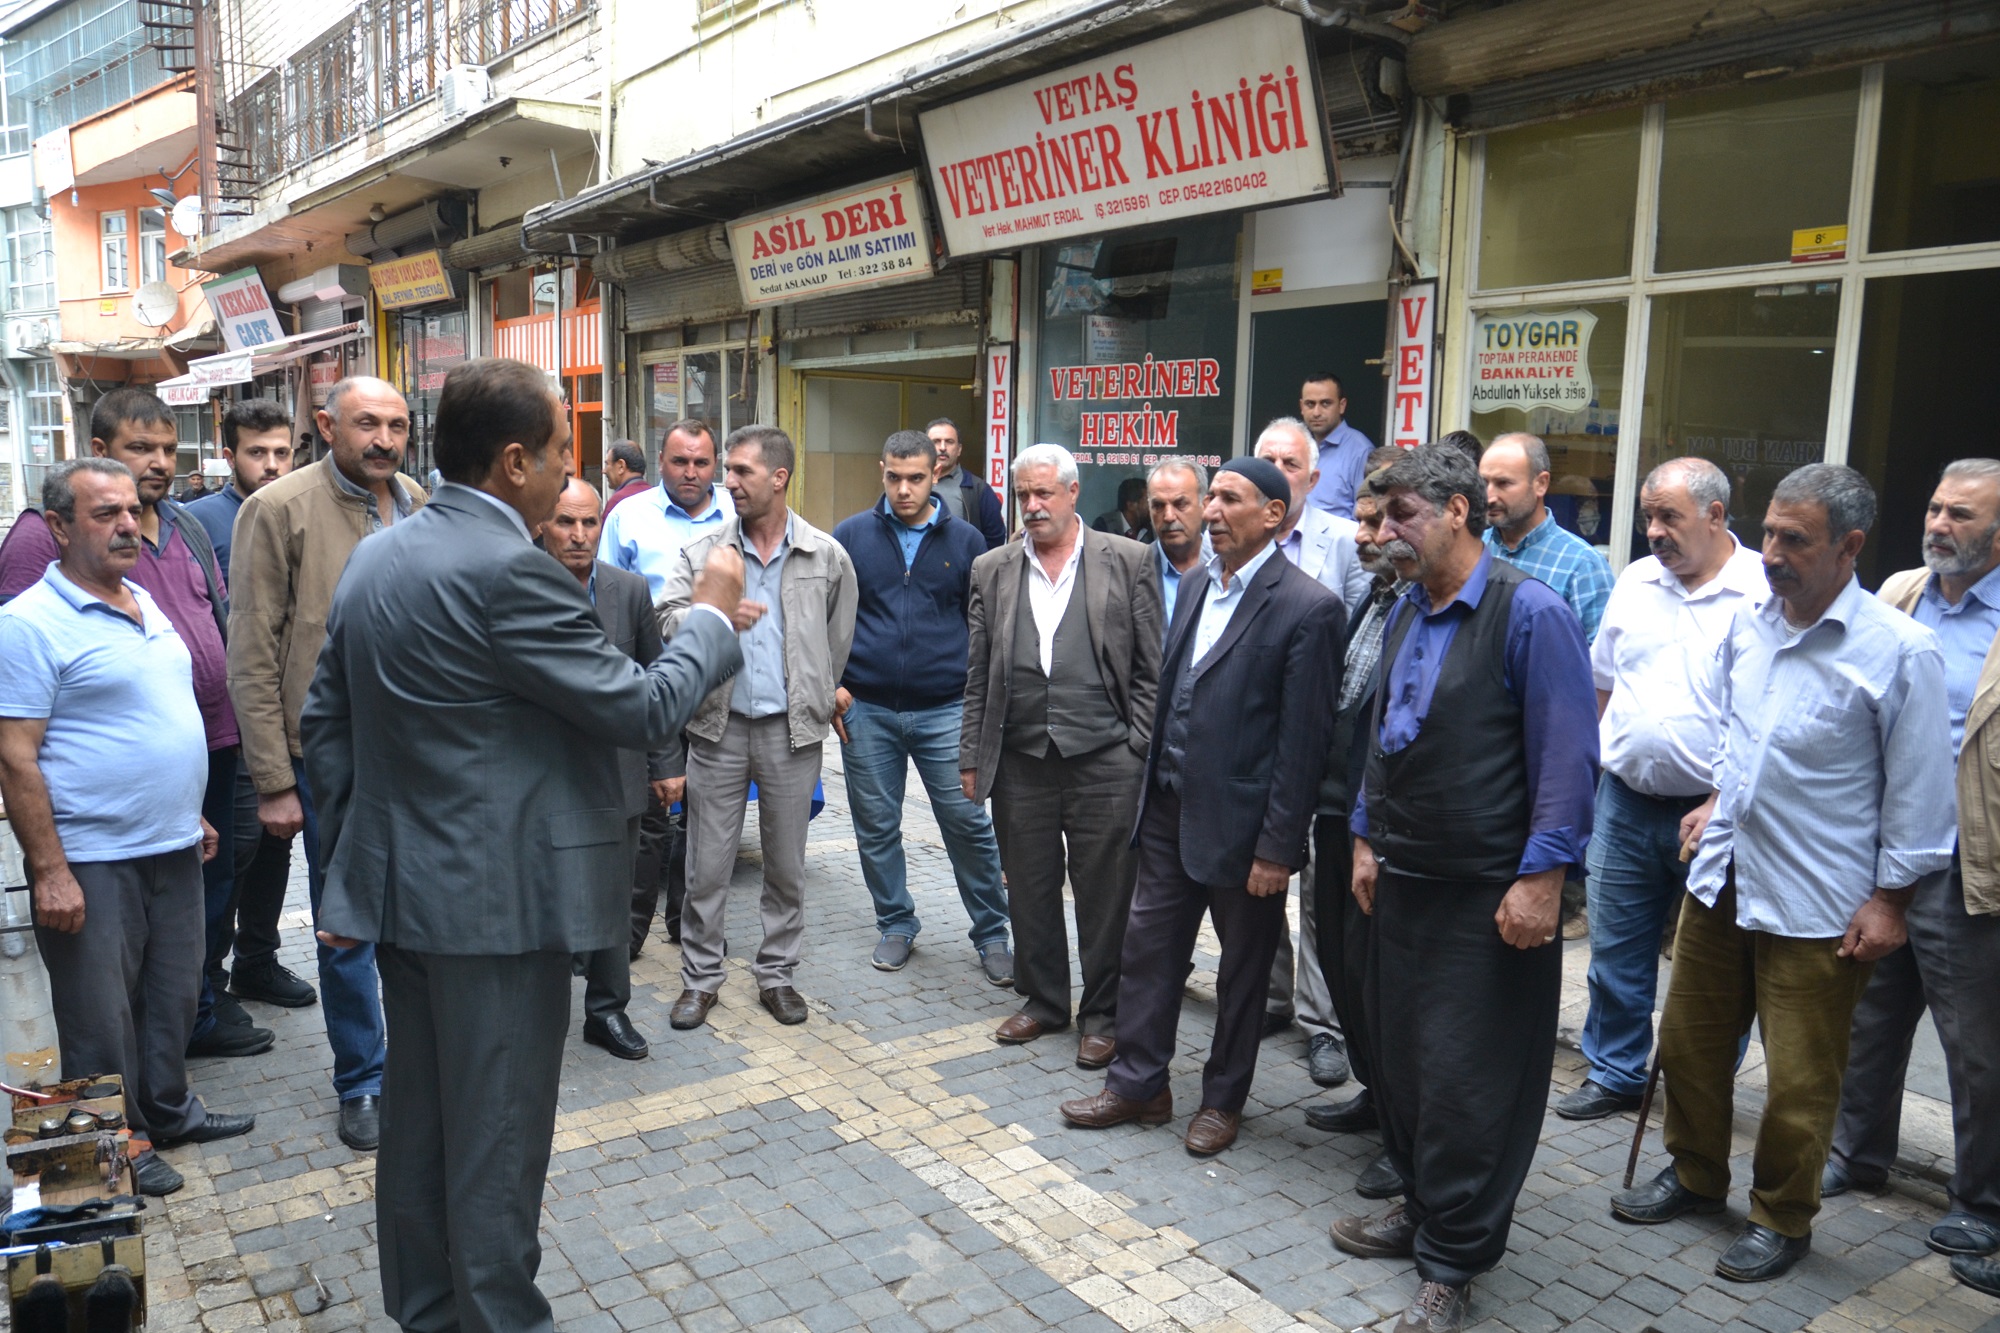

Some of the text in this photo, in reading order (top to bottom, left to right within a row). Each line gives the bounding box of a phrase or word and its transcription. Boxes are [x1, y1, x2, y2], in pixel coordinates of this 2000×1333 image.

[1034, 63, 1138, 125] VETAŞ
[939, 65, 1308, 219] VETERİNER KLİNİĞİ
[752, 186, 907, 260] ASİL DERİ
[1014, 213, 1051, 232] MAHMUT
[1054, 207, 1084, 225] ERDAL
[750, 231, 916, 281] DERİ ve GÖN ALIM SATIMI
[759, 284, 783, 295] Sedat
[784, 273, 828, 290] ASLANALP
[858, 264, 879, 276] 322
[881, 260, 896, 272] 38
[898, 256, 913, 268] 84
[217, 280, 269, 318] KEKLİK
[235, 319, 275, 347] CAFE
[1484, 320, 1582, 350] TOYGAR
[1050, 352, 1220, 400] VETERİNER
[1396, 297, 1427, 450] VET
[1479, 350, 1578, 364] TOPTAN PERAKENDE
[1472, 383, 1587, 400] Abdullah Yüksek 31918
[991, 355, 1007, 505] VETE
[1080, 402, 1178, 447] HEKİM
